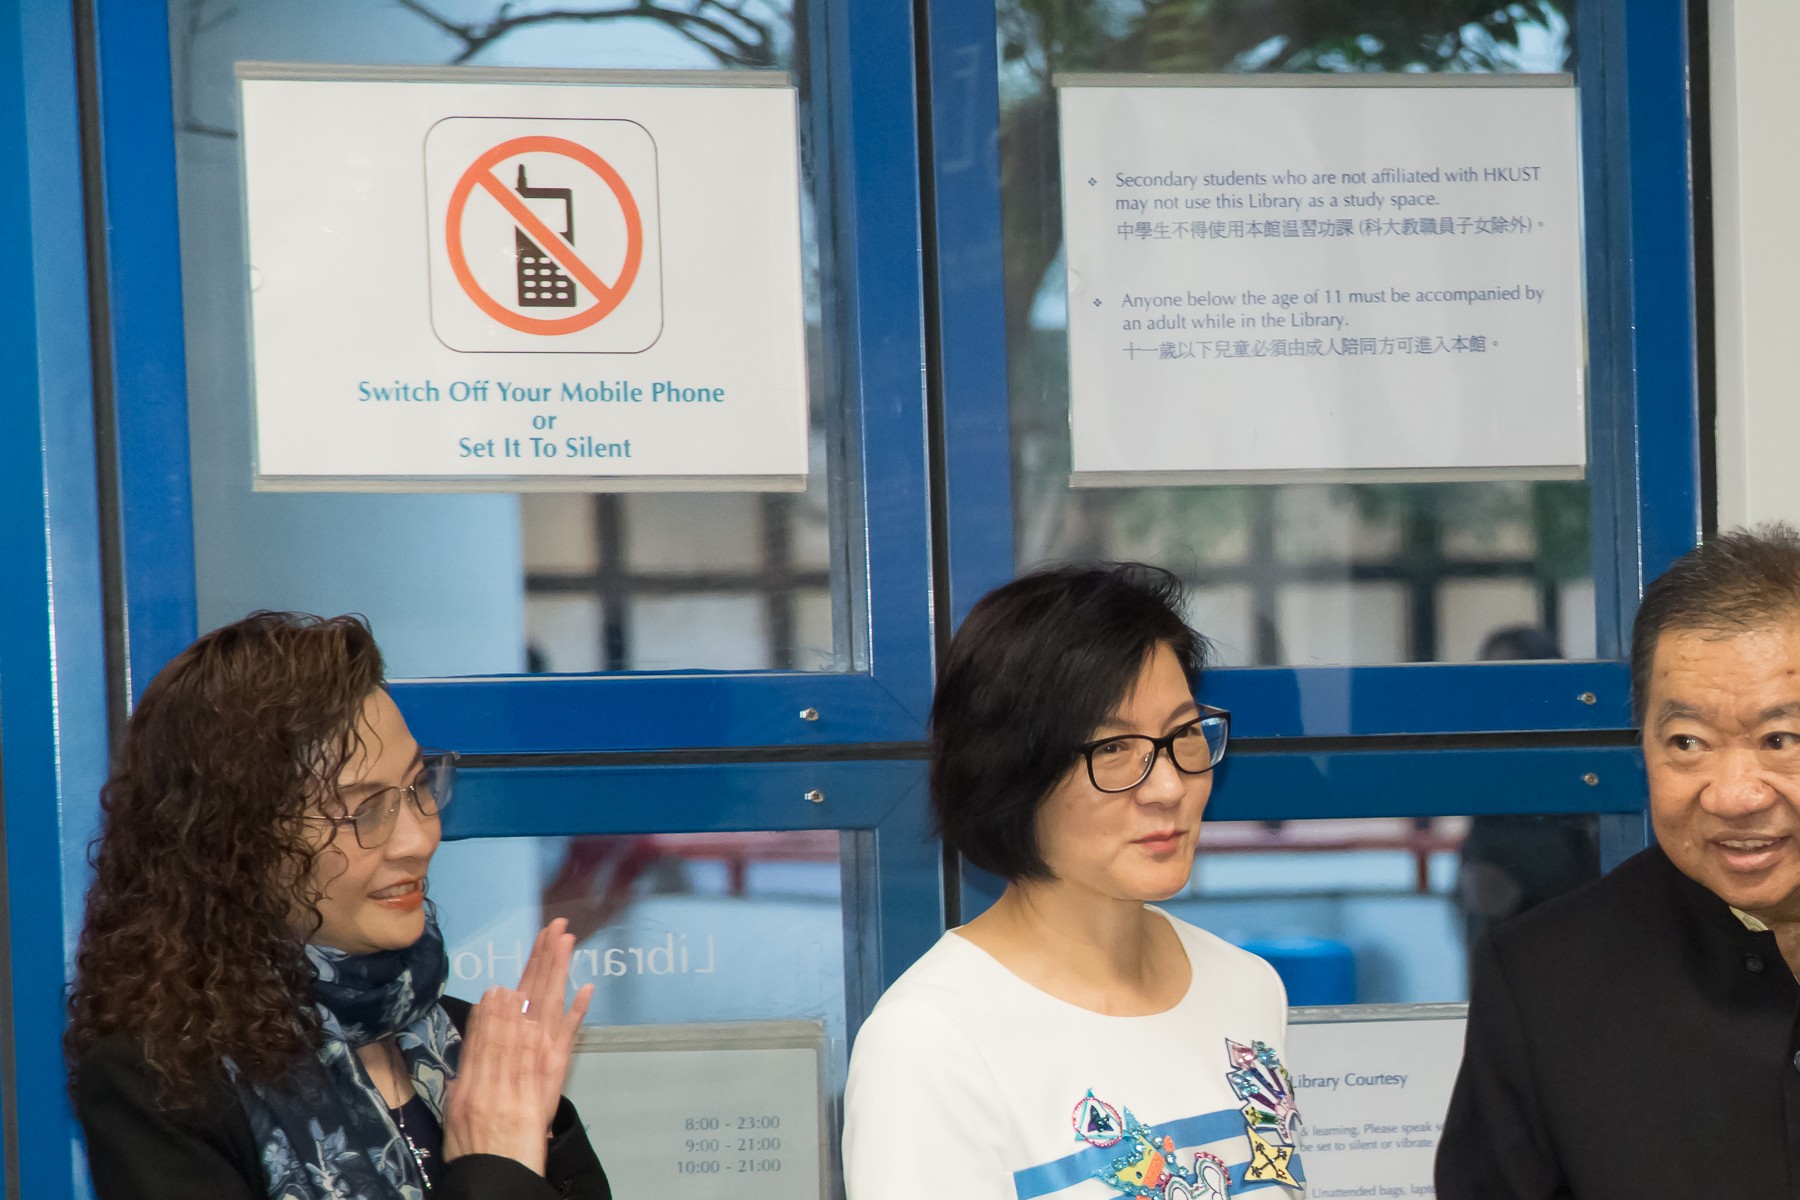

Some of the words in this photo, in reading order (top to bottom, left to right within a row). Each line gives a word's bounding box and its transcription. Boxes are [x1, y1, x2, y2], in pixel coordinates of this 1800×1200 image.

[1116, 171, 1197, 190] Secondary
[1203, 170, 1267, 186] students
[1272, 170, 1306, 185] who
[1312, 173, 1336, 185] are
[1342, 172, 1366, 184] not
[1372, 167, 1440, 183] affiliated
[1445, 167, 1477, 182] with
[1484, 167, 1541, 181] HKUST
[1116, 198, 1147, 214] may
[1154, 197, 1178, 209] not
[1185, 197, 1211, 209] use
[1216, 193, 1243, 209] this
[1249, 193, 1302, 212] Library
[1309, 196, 1323, 207] as
[1330, 196, 1337, 207] a
[1344, 192, 1384, 210] study
[1391, 194, 1439, 210] space.
[1122, 293, 1182, 311] Anyone
[1188, 291, 1235, 306] below
[1242, 290, 1267, 305] the
[1272, 293, 1298, 309] age
[1303, 289, 1318, 304] of
[1326, 289, 1341, 304] 11
[1349, 289, 1385, 303] must
[1391, 287, 1410, 302] be
[1416, 285, 1520, 305] accompanied
[1525, 285, 1544, 304] by
[1123, 319, 1141, 330] an
[1147, 313, 1186, 329] adult
[1191, 313, 1235, 329] while
[1242, 313, 1255, 328] in
[1261, 312, 1285, 327] the
[1291, 312, 1349, 331] Library.
[359, 380, 439, 401] Switch
[449, 381, 489, 401] Off
[496, 382, 551, 401] Your
[561, 381, 642, 402] Mobile
[652, 381, 724, 402] Phone
[533, 416, 557, 429] or
[459, 438, 494, 457] Set
[505, 438, 520, 457] It
[530, 438, 556, 457] To
[566, 436, 631, 457] Silent
[1290, 1074, 1339, 1091] Library
[1344, 1073, 1408, 1088] Courtesy
[685, 1117, 720, 1130] 8:00
[737, 1115, 781, 1130] 23:00
[1364, 1123, 1398, 1134] Please
[1402, 1121, 1432, 1134] speak
[685, 1139, 720, 1153] 9:00
[737, 1137, 781, 1152] 21:00
[1317, 1143, 1331, 1151] set
[1349, 1140, 1376, 1149] silent
[1381, 1140, 1392, 1148] or
[677, 1160, 720, 1174] 10:00
[737, 1159, 782, 1173] 21:00
[1312, 1185, 1376, 1198] Unattended
